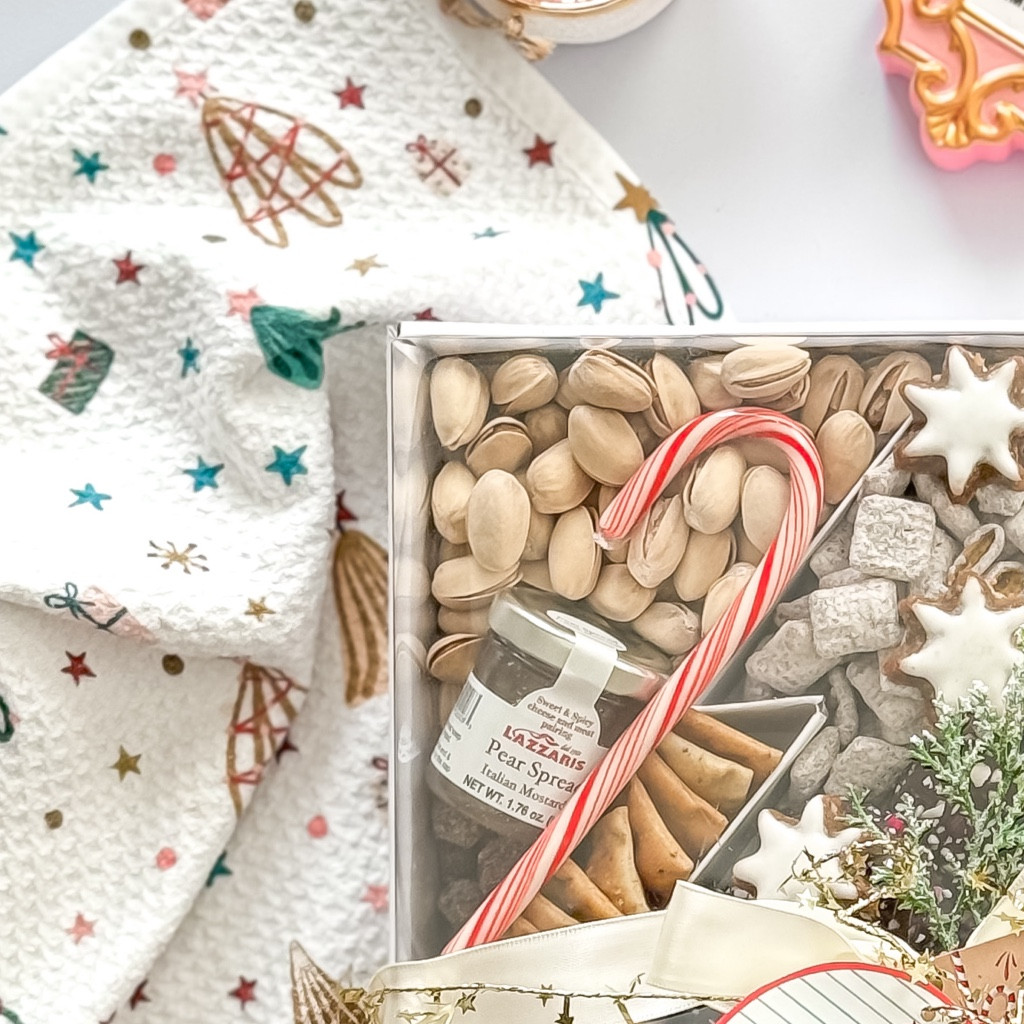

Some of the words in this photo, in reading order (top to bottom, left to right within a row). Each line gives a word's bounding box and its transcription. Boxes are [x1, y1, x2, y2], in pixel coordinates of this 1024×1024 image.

[527, 703, 556, 721] cheese
[557, 717, 574, 730] and
[574, 725, 595, 738] meat
[536, 696, 563, 712] Sweet
[563, 708, 571, 717] &
[571, 711, 595, 728] Spicy
[540, 721, 573, 741] pairing
[485, 737, 526, 772] Pear
[527, 761, 580, 793] Sprea
[502, 725, 587, 771] LAZZARIS
[463, 774, 486, 793] NET
[486, 786, 505, 805] WT.
[507, 799, 530, 816] 1.76
[480, 763, 518, 791] Italian
[519, 783, 568, 811] Mostard
